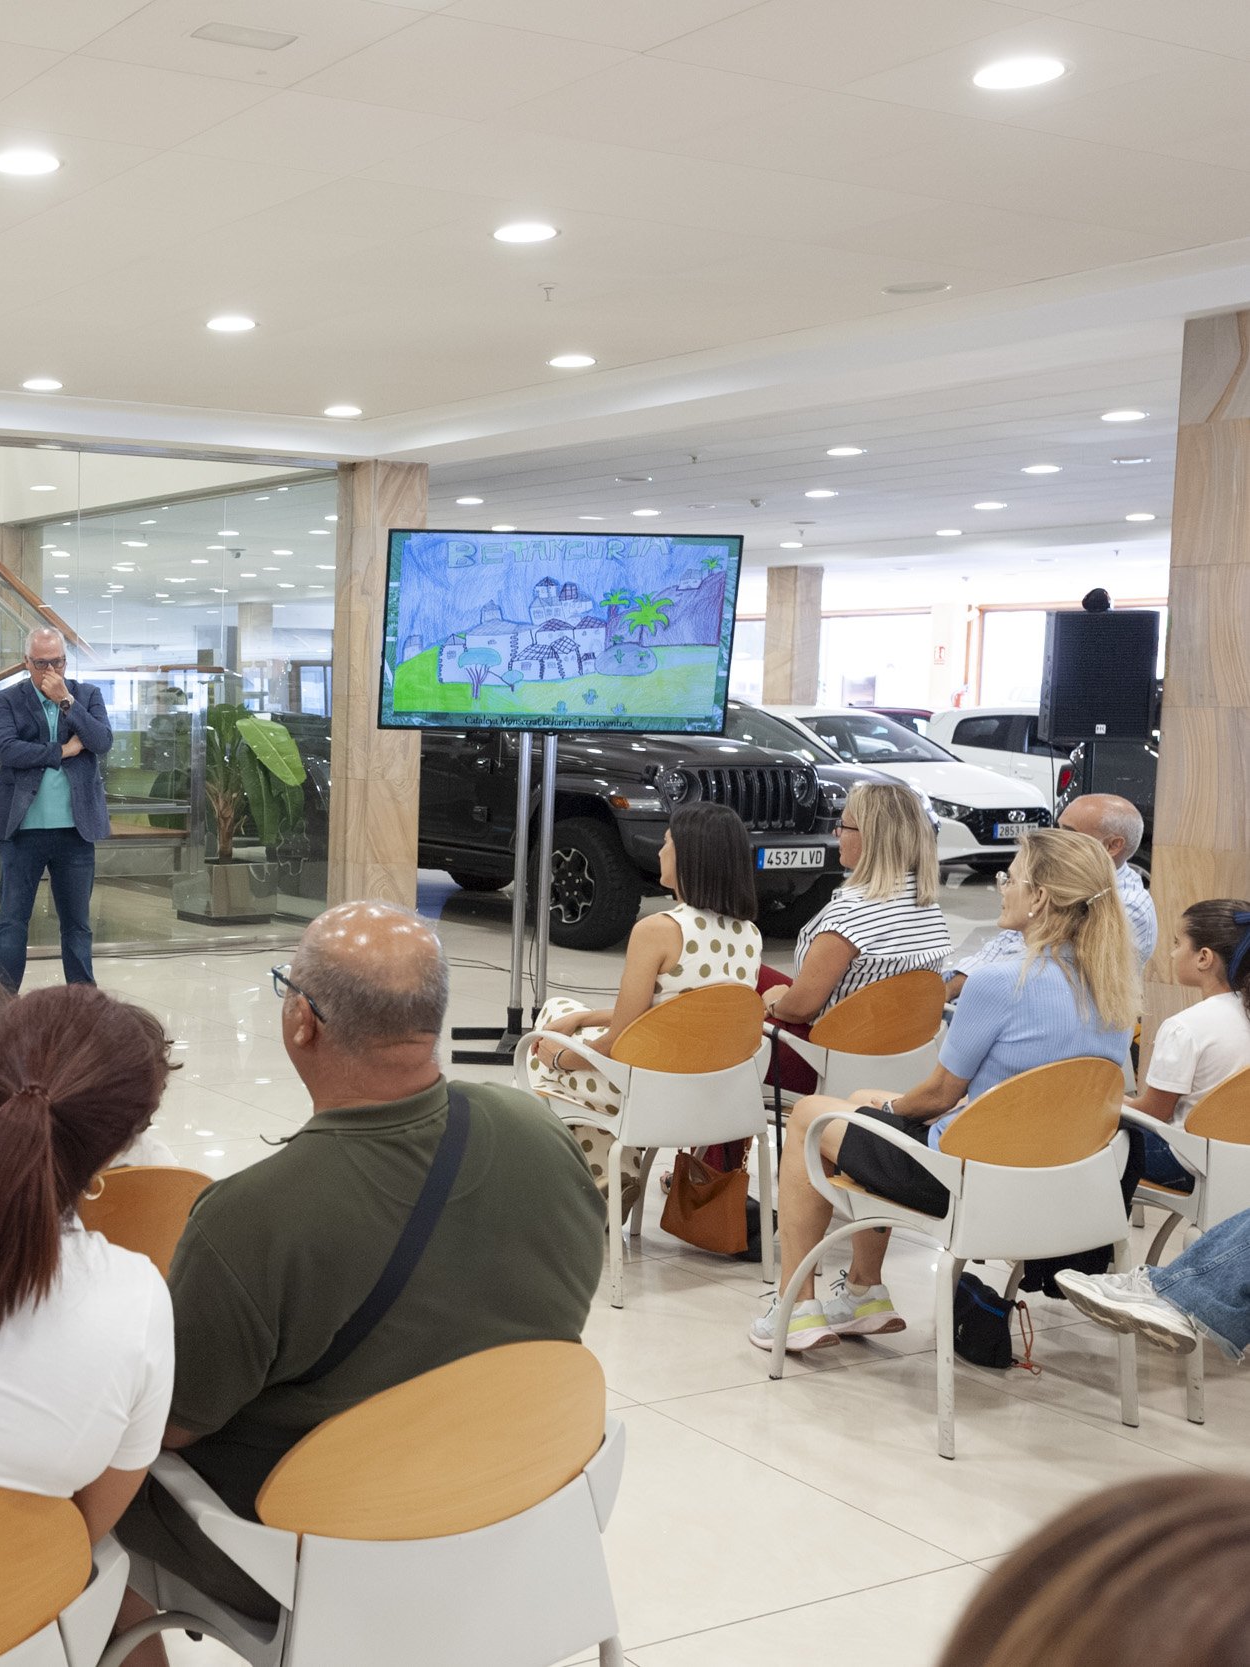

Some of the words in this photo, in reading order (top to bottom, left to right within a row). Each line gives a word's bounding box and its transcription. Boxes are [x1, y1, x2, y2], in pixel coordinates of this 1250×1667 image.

[447, 537, 672, 569] BETANCURIA
[767, 851, 798, 866] 4537
[801, 850, 822, 865] LVD
